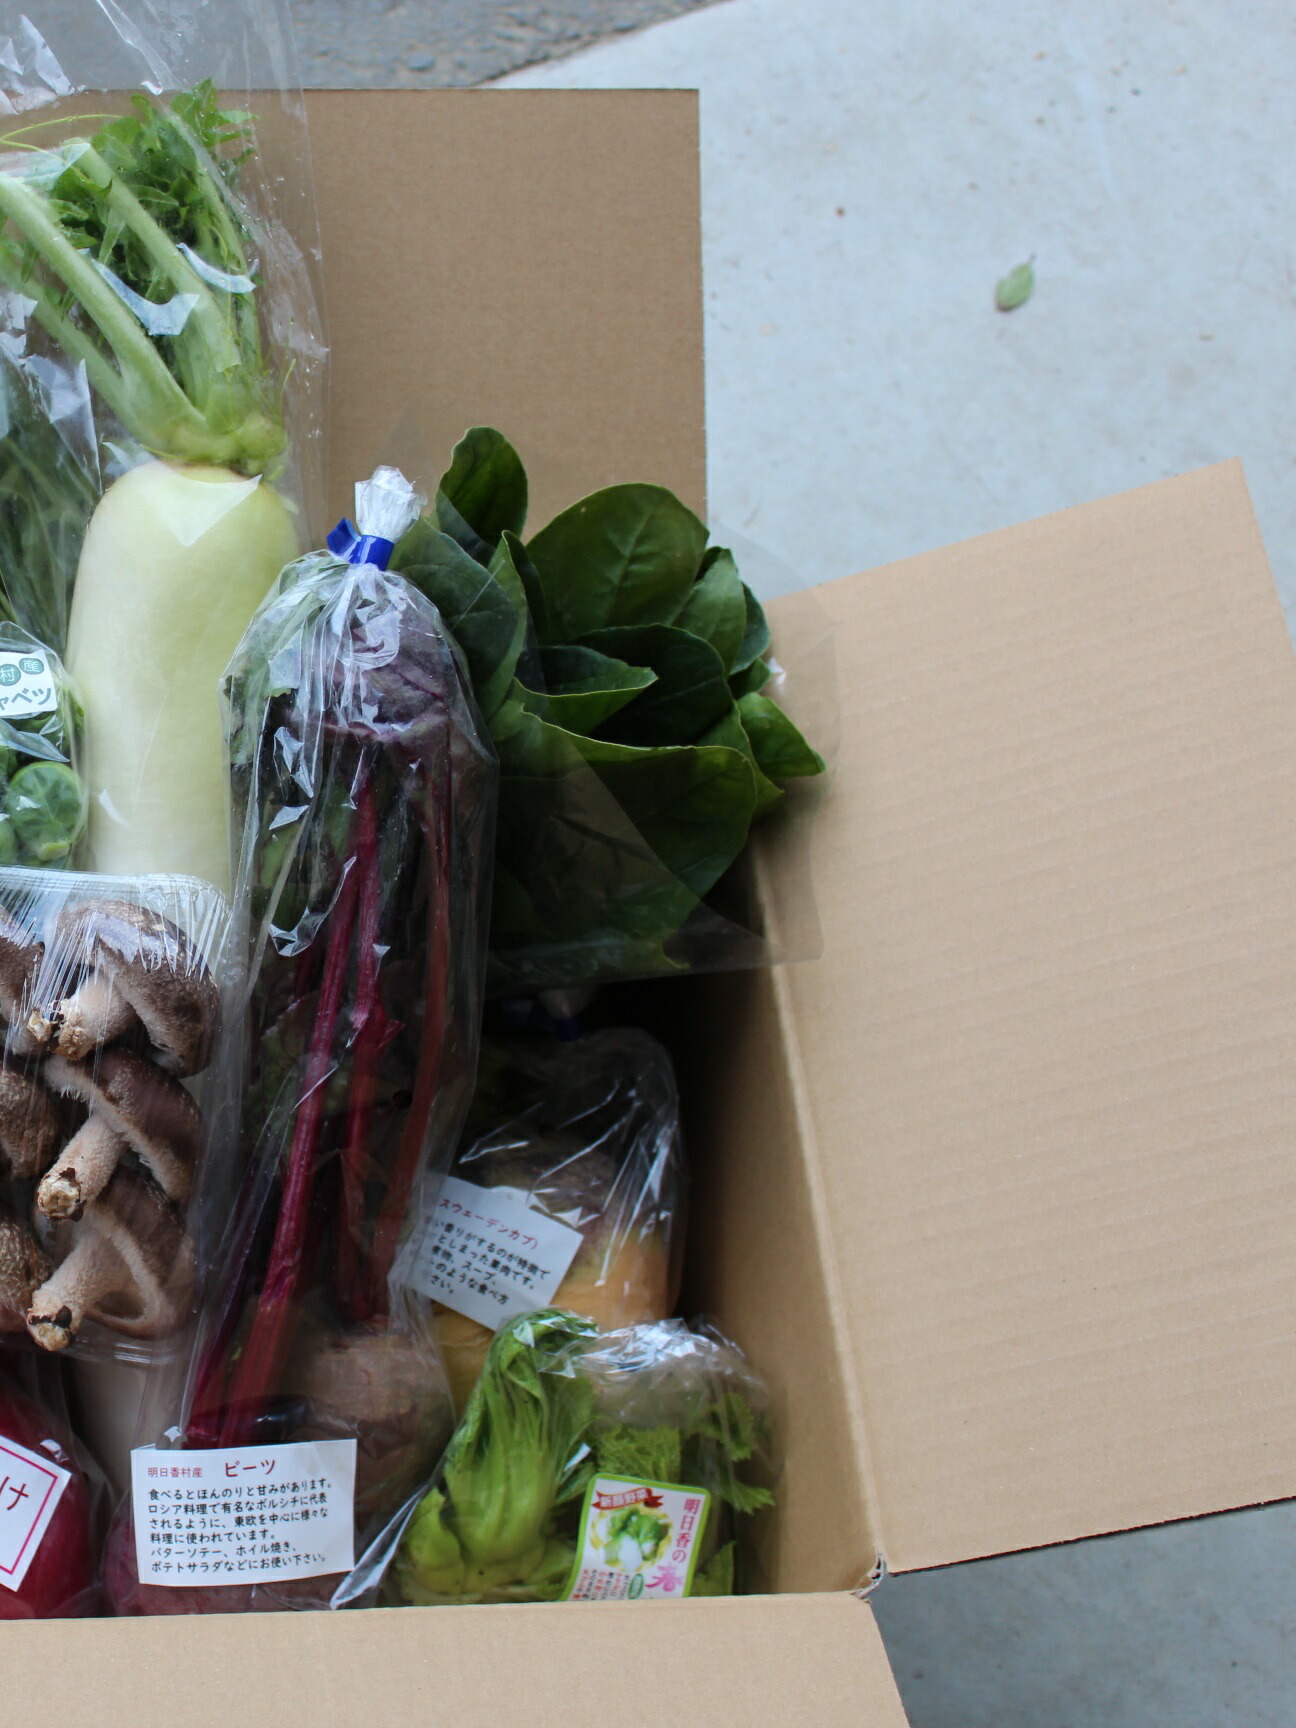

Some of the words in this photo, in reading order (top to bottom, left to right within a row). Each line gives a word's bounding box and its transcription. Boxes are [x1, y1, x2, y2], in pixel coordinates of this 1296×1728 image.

[147, 1467, 203, 1478] 明日香村産
[224, 1459, 276, 1477] ビーツ
[148, 1477, 333, 1501] 食べるとほんのりと甘みがあります。
[149, 1507, 329, 1529] されるように、東欧を中心に様々な
[150, 1528, 276, 1544] 料理に使われています。
[150, 1541, 297, 1559] バターソテー、ホイル焼き、
[151, 1552, 326, 1573] ポテトサラダなどにお使い下さい。
